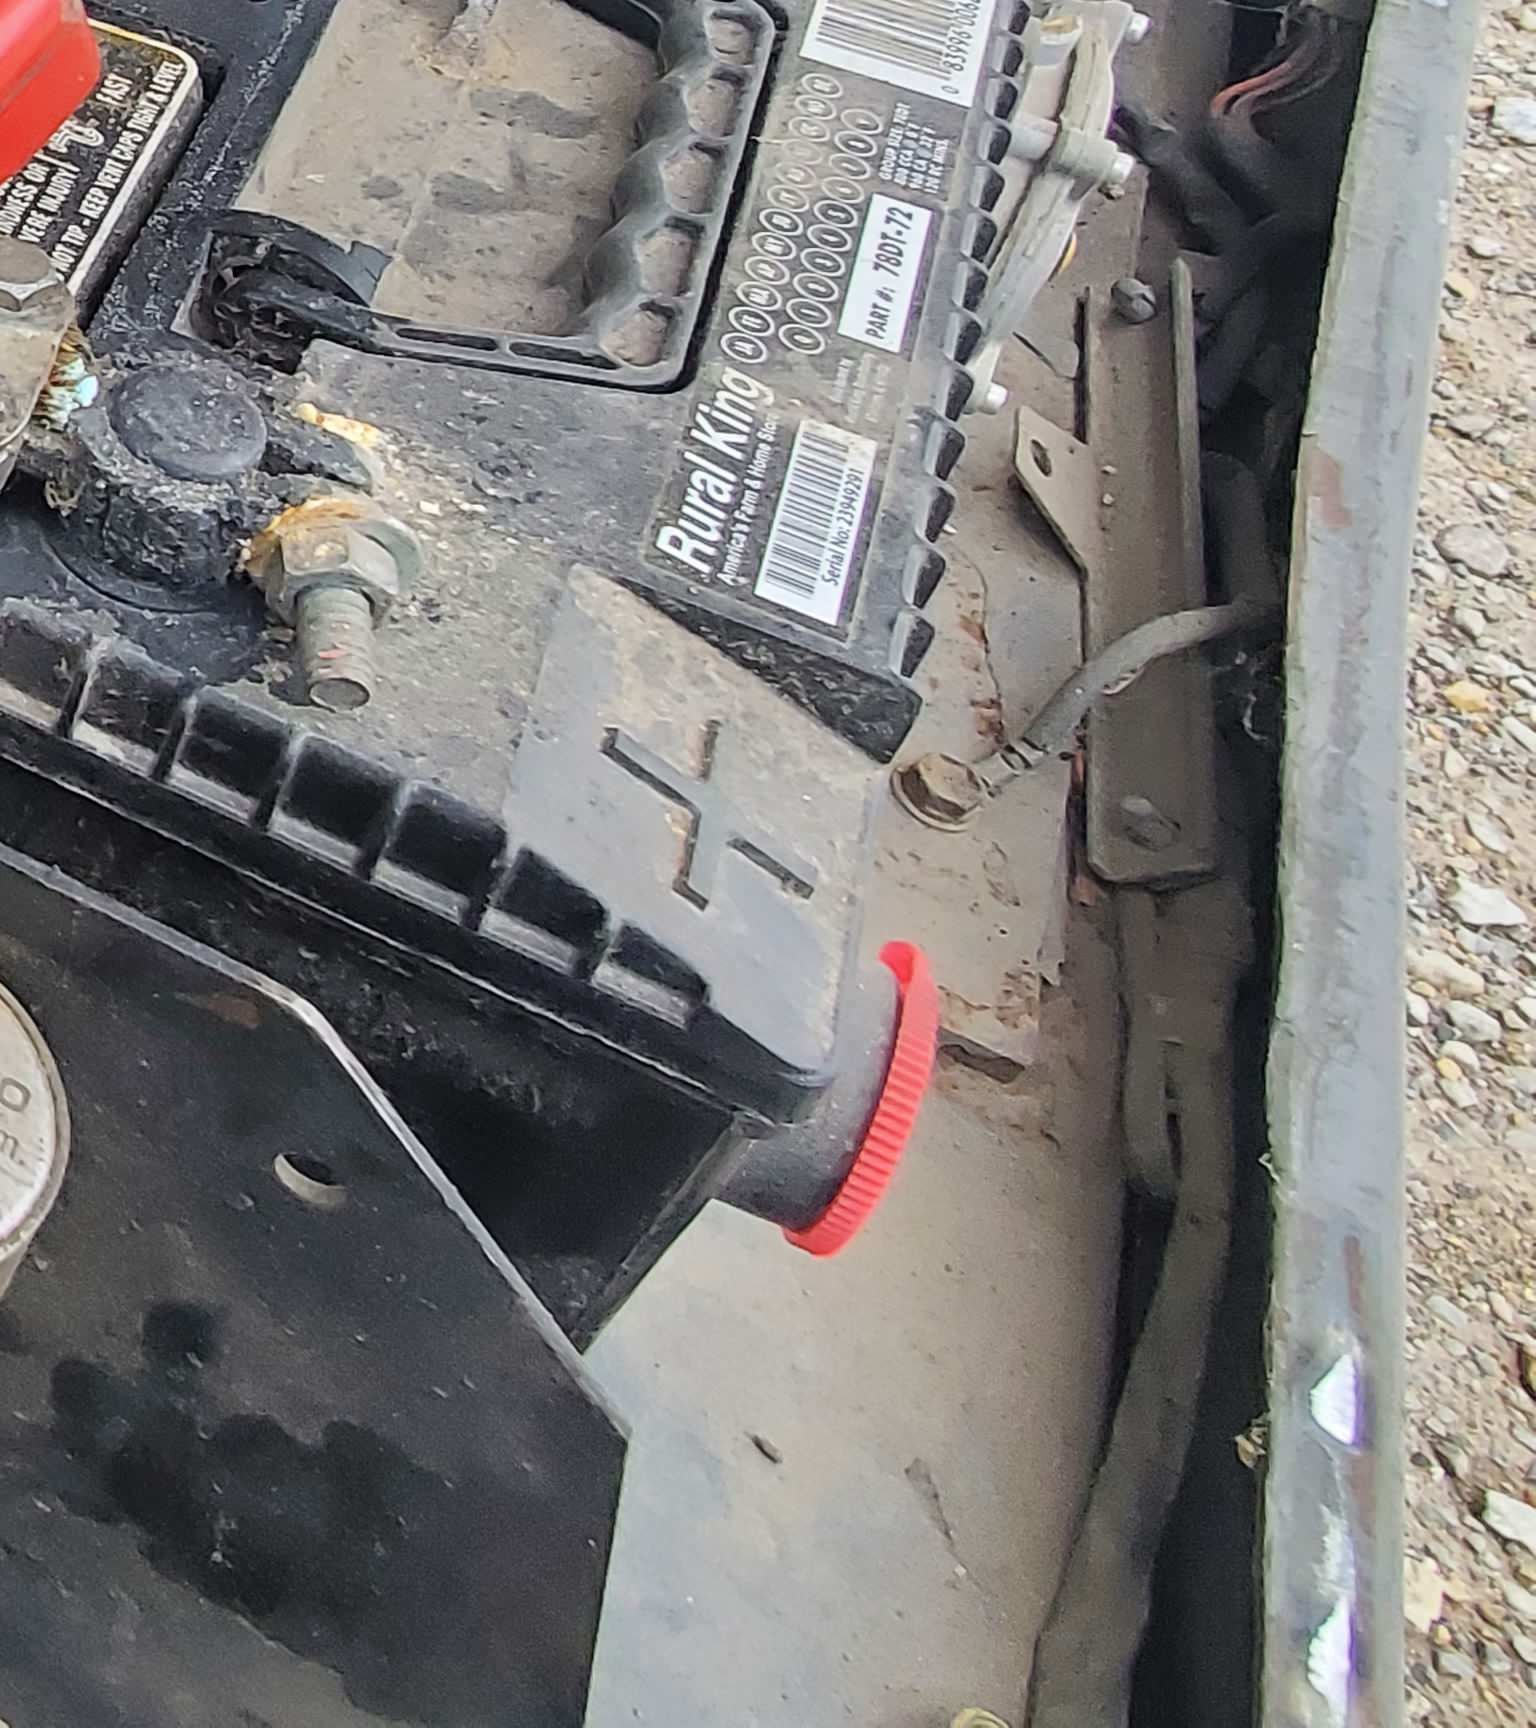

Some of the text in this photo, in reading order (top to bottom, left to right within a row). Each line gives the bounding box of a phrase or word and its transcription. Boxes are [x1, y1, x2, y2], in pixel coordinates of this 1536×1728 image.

[95, 72, 133, 107] FAST
[150, 60, 184, 93] LEVEL
[940, 82, 959, 96] 0
[126, 95, 161, 133] TIGHT
[109, 130, 144, 161] CAPS
[877, 146, 898, 180] GROUP
[22, 162, 51, 183] OR
[36, 167, 78, 212] INJURY
[93, 158, 128, 189] VENT
[78, 187, 109, 219] KEEP
[60, 224, 89, 246] TIP
[872, 206, 914, 277] 78DT-72
[864, 301, 891, 339] PART
[653, 364, 775, 576] Rural King
[748, 441, 773, 479] Home
[744, 477, 762, 490] &
[736, 488, 759, 523] Farm
[821, 467, 864, 586] Serial No: 23949291
[717, 521, 751, 586] America's
